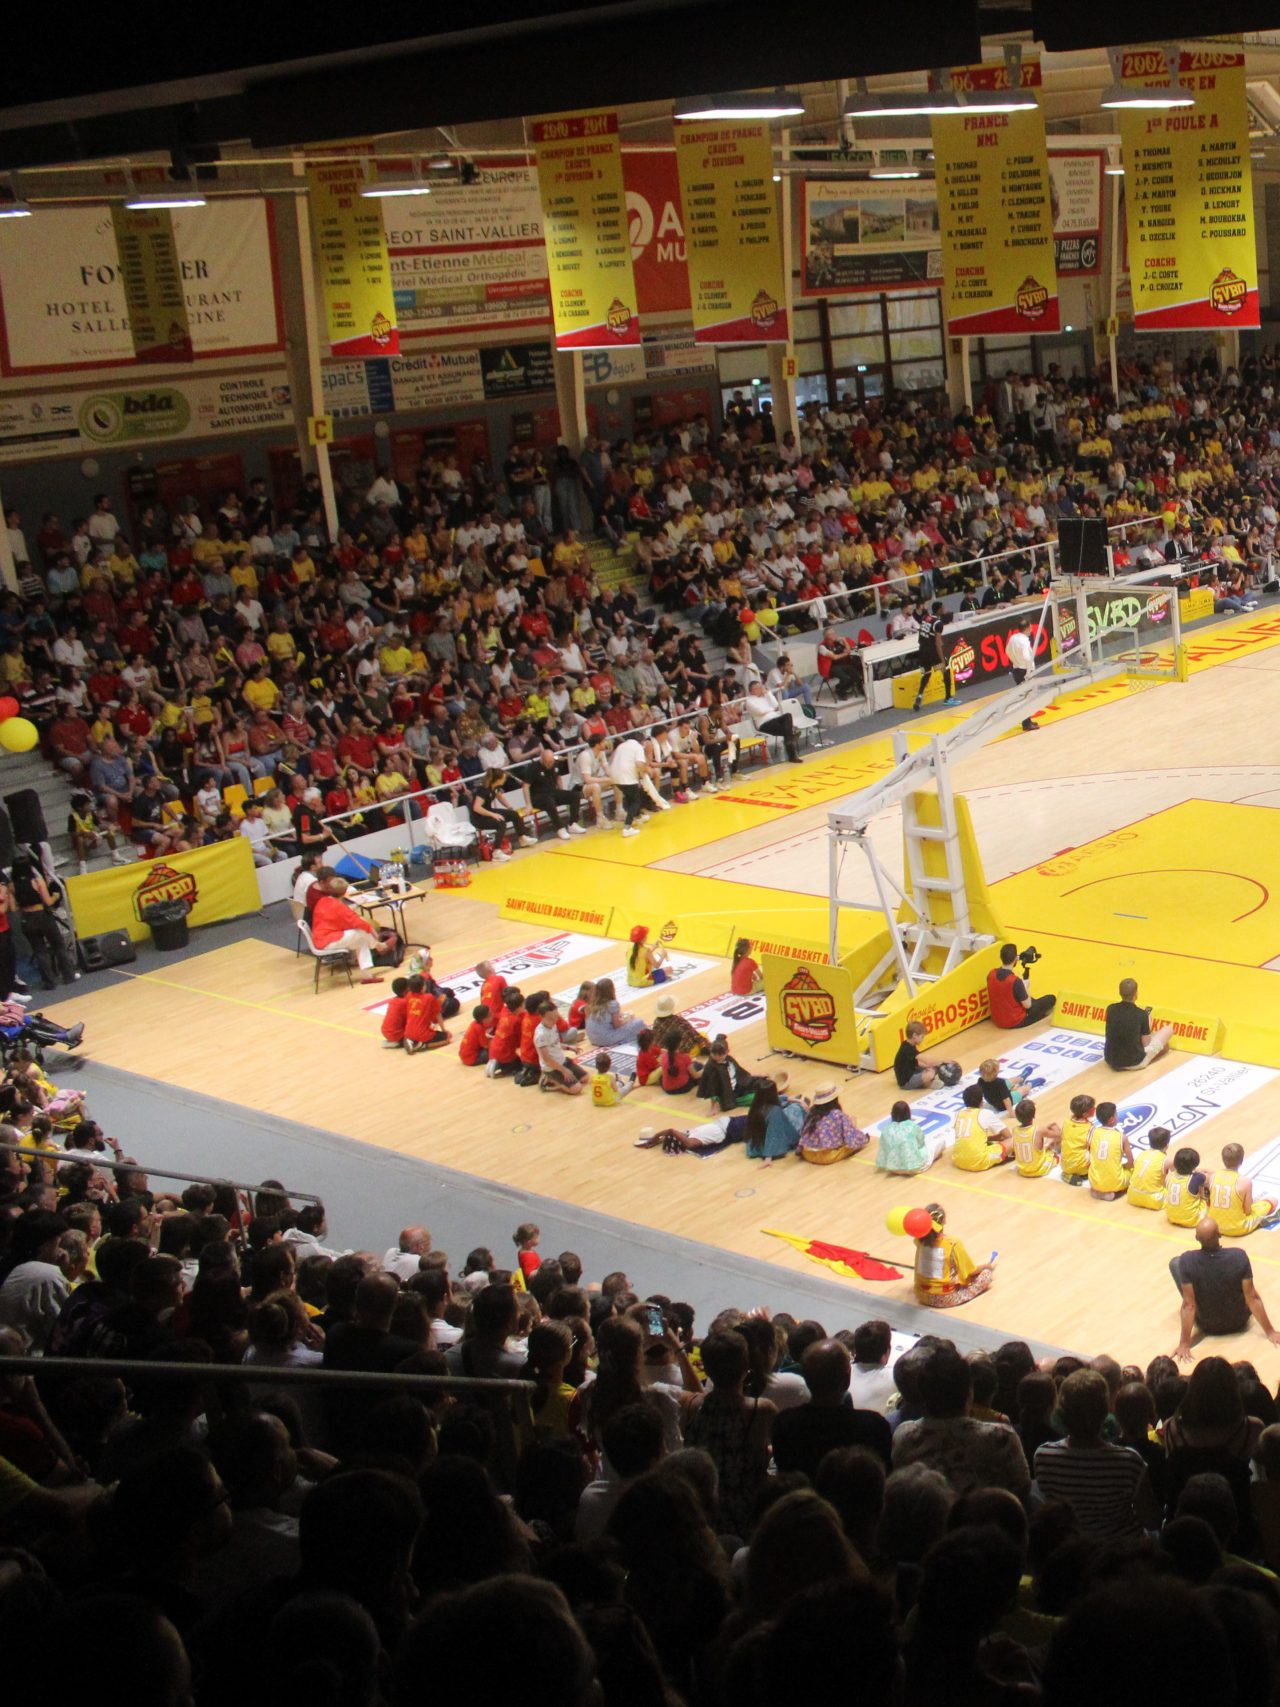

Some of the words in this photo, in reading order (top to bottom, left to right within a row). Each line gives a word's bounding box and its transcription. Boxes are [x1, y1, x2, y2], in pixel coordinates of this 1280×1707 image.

[1199, 75, 1216, 90] EN
[964, 114, 1009, 131] FRANCE
[1165, 115, 1206, 131] POULE
[1210, 114, 1218, 128] A
[430, 223, 539, 242] SAINT-VALLIER
[472, 251, 526, 266] Médical
[1145, 258, 1176, 268] COACHS
[419, 272, 463, 285] Médical
[467, 268, 527, 282] Orthopédie
[1214, 282, 1246, 303] SVBD
[46, 300, 115, 318] HOTEL
[72, 317, 131, 334] SALLE
[392, 356, 428, 372] Crédit
[441, 355, 480, 367] Mutuel
[219, 379, 265, 391] CONTROLE
[220, 390, 269, 404] TECHNIQUE
[218, 402, 274, 416] AUTOMOBILE
[314, 420, 327, 440] C
[750, 763, 850, 798] SAINT
[775, 755, 899, 800] VALLIE
[506, 897, 552, 918] SAINT-VALLIER
[553, 905, 579, 921] BASKET
[792, 947, 822, 963] BASKET
[786, 994, 836, 1022] SVBD
[1173, 1019, 1210, 1042] DRÔME
[1213, 1184, 1232, 1209] 13
